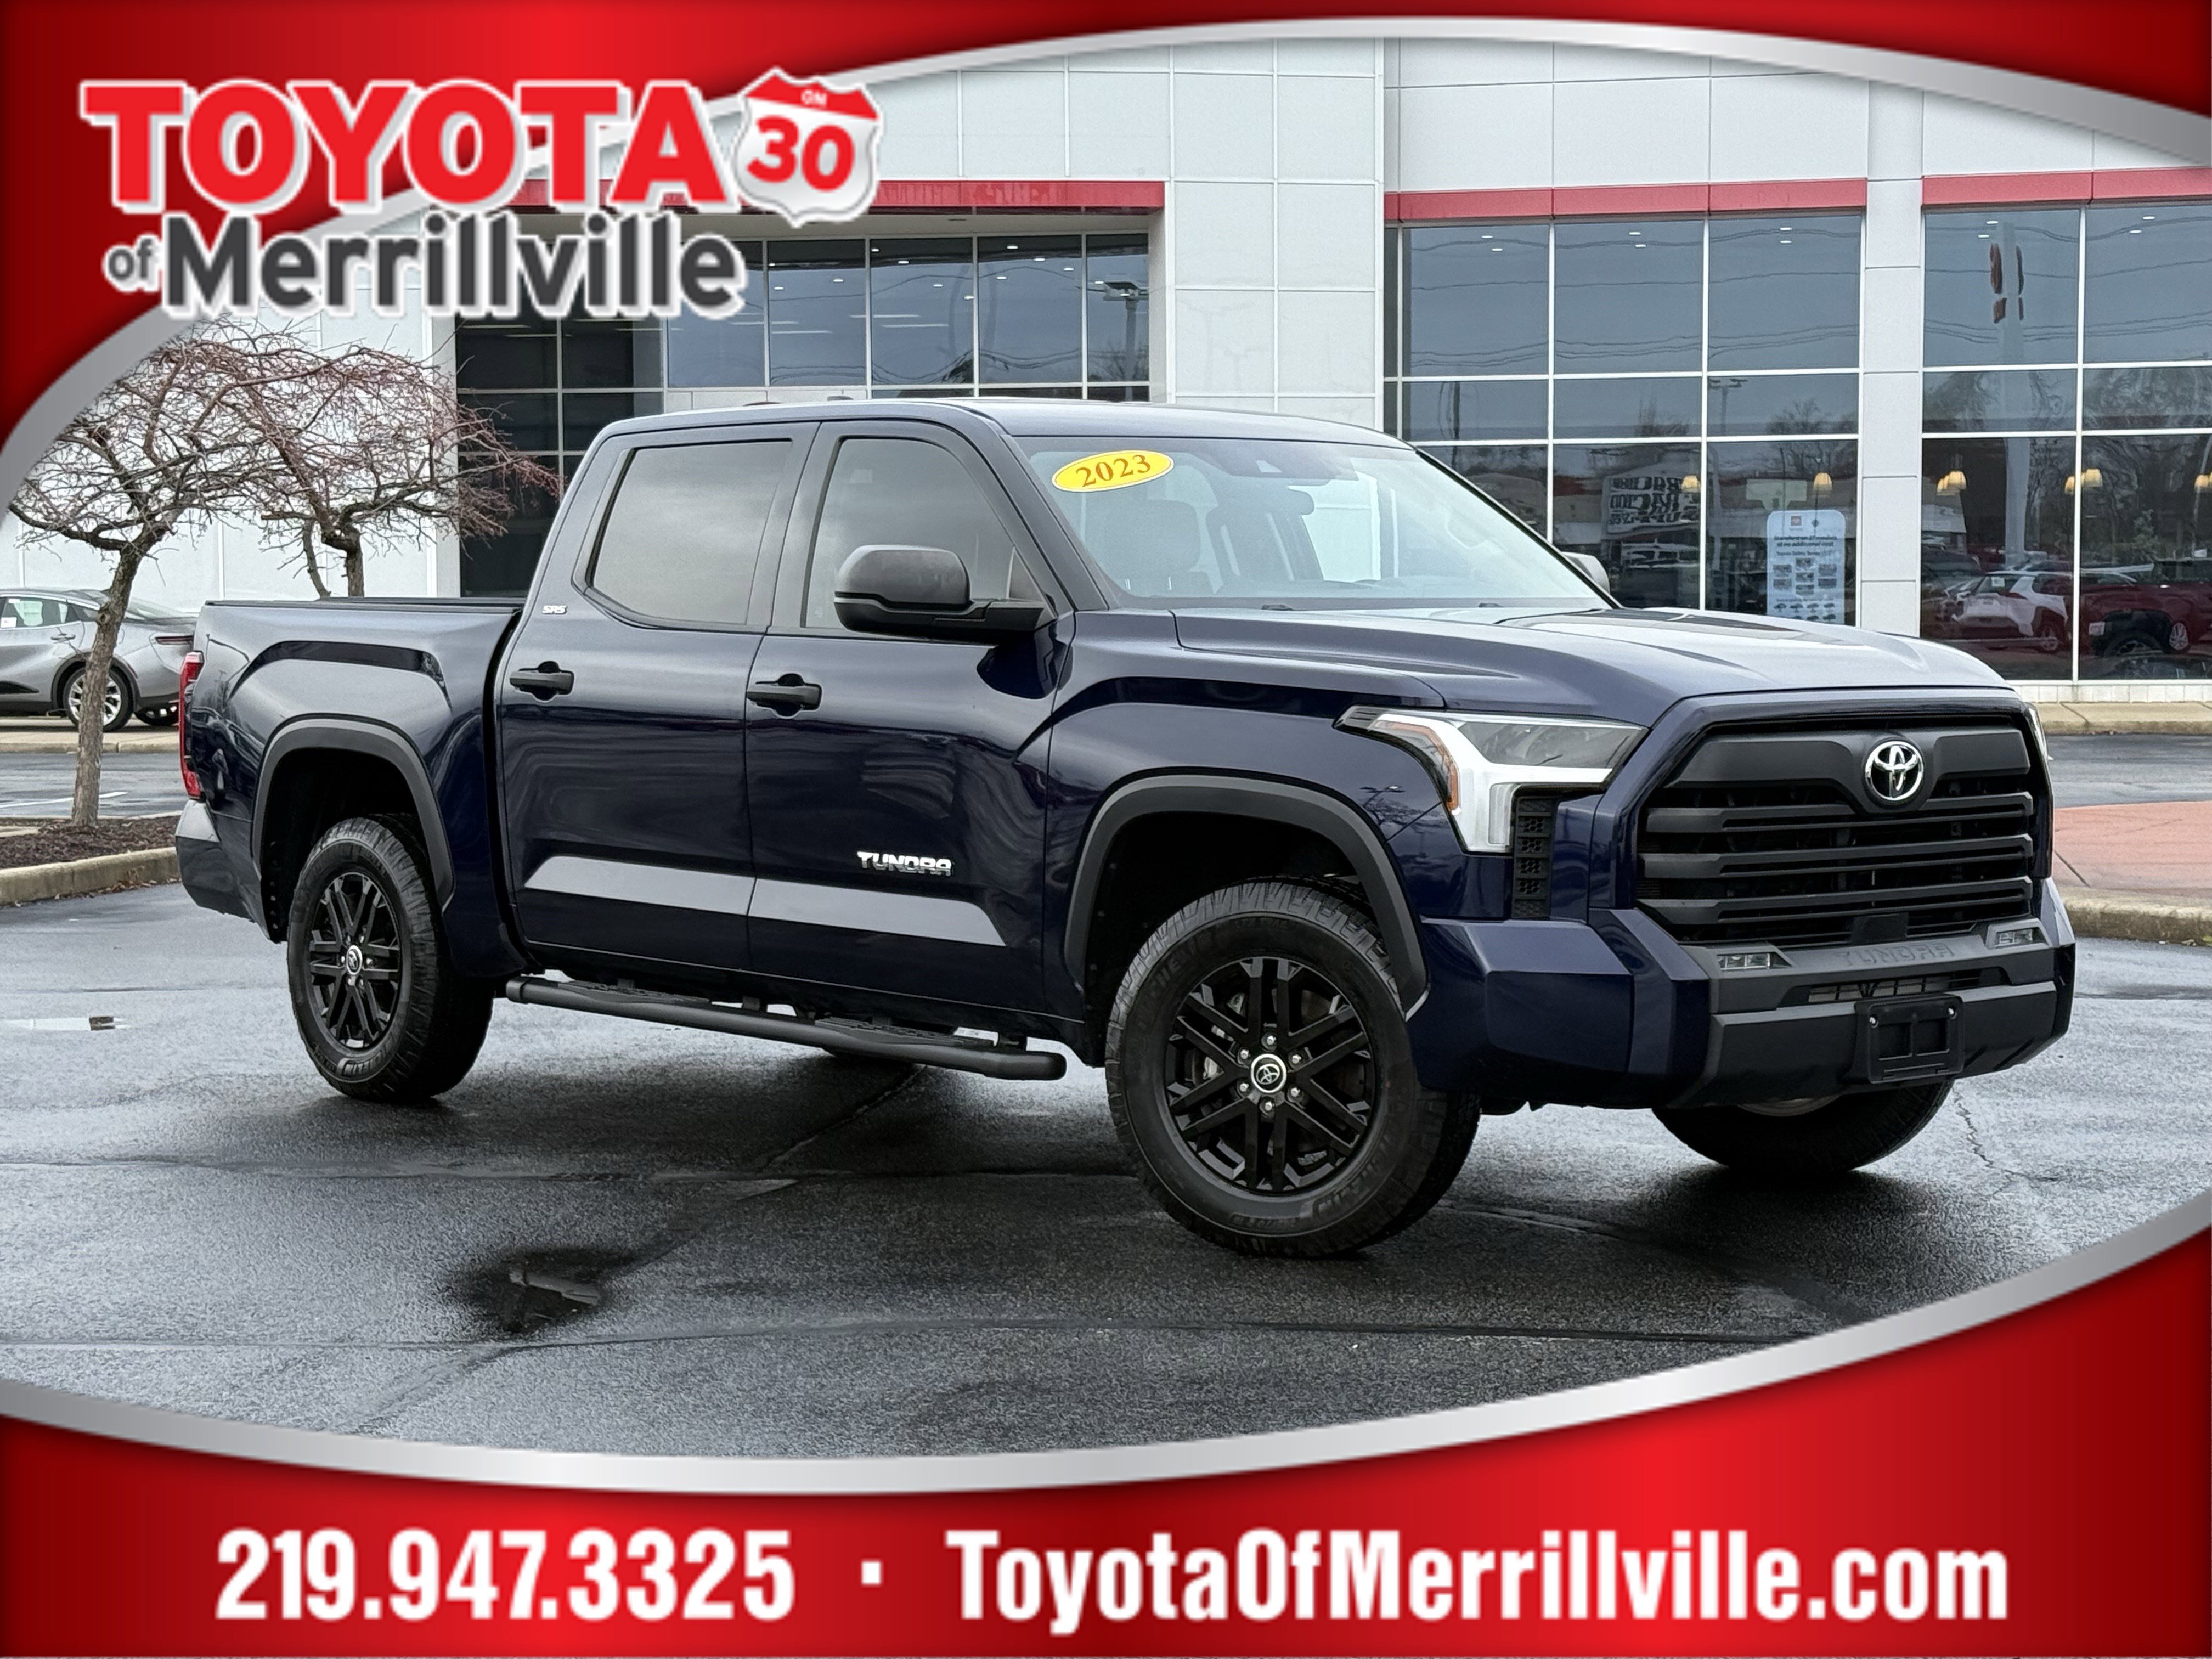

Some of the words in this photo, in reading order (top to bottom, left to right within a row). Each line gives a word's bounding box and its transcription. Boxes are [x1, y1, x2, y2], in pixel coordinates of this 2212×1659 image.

[1076, 454, 1151, 488] 2023
[857, 851, 952, 877] TUNDRA
[1838, 943, 1955, 966] TUNDRA
